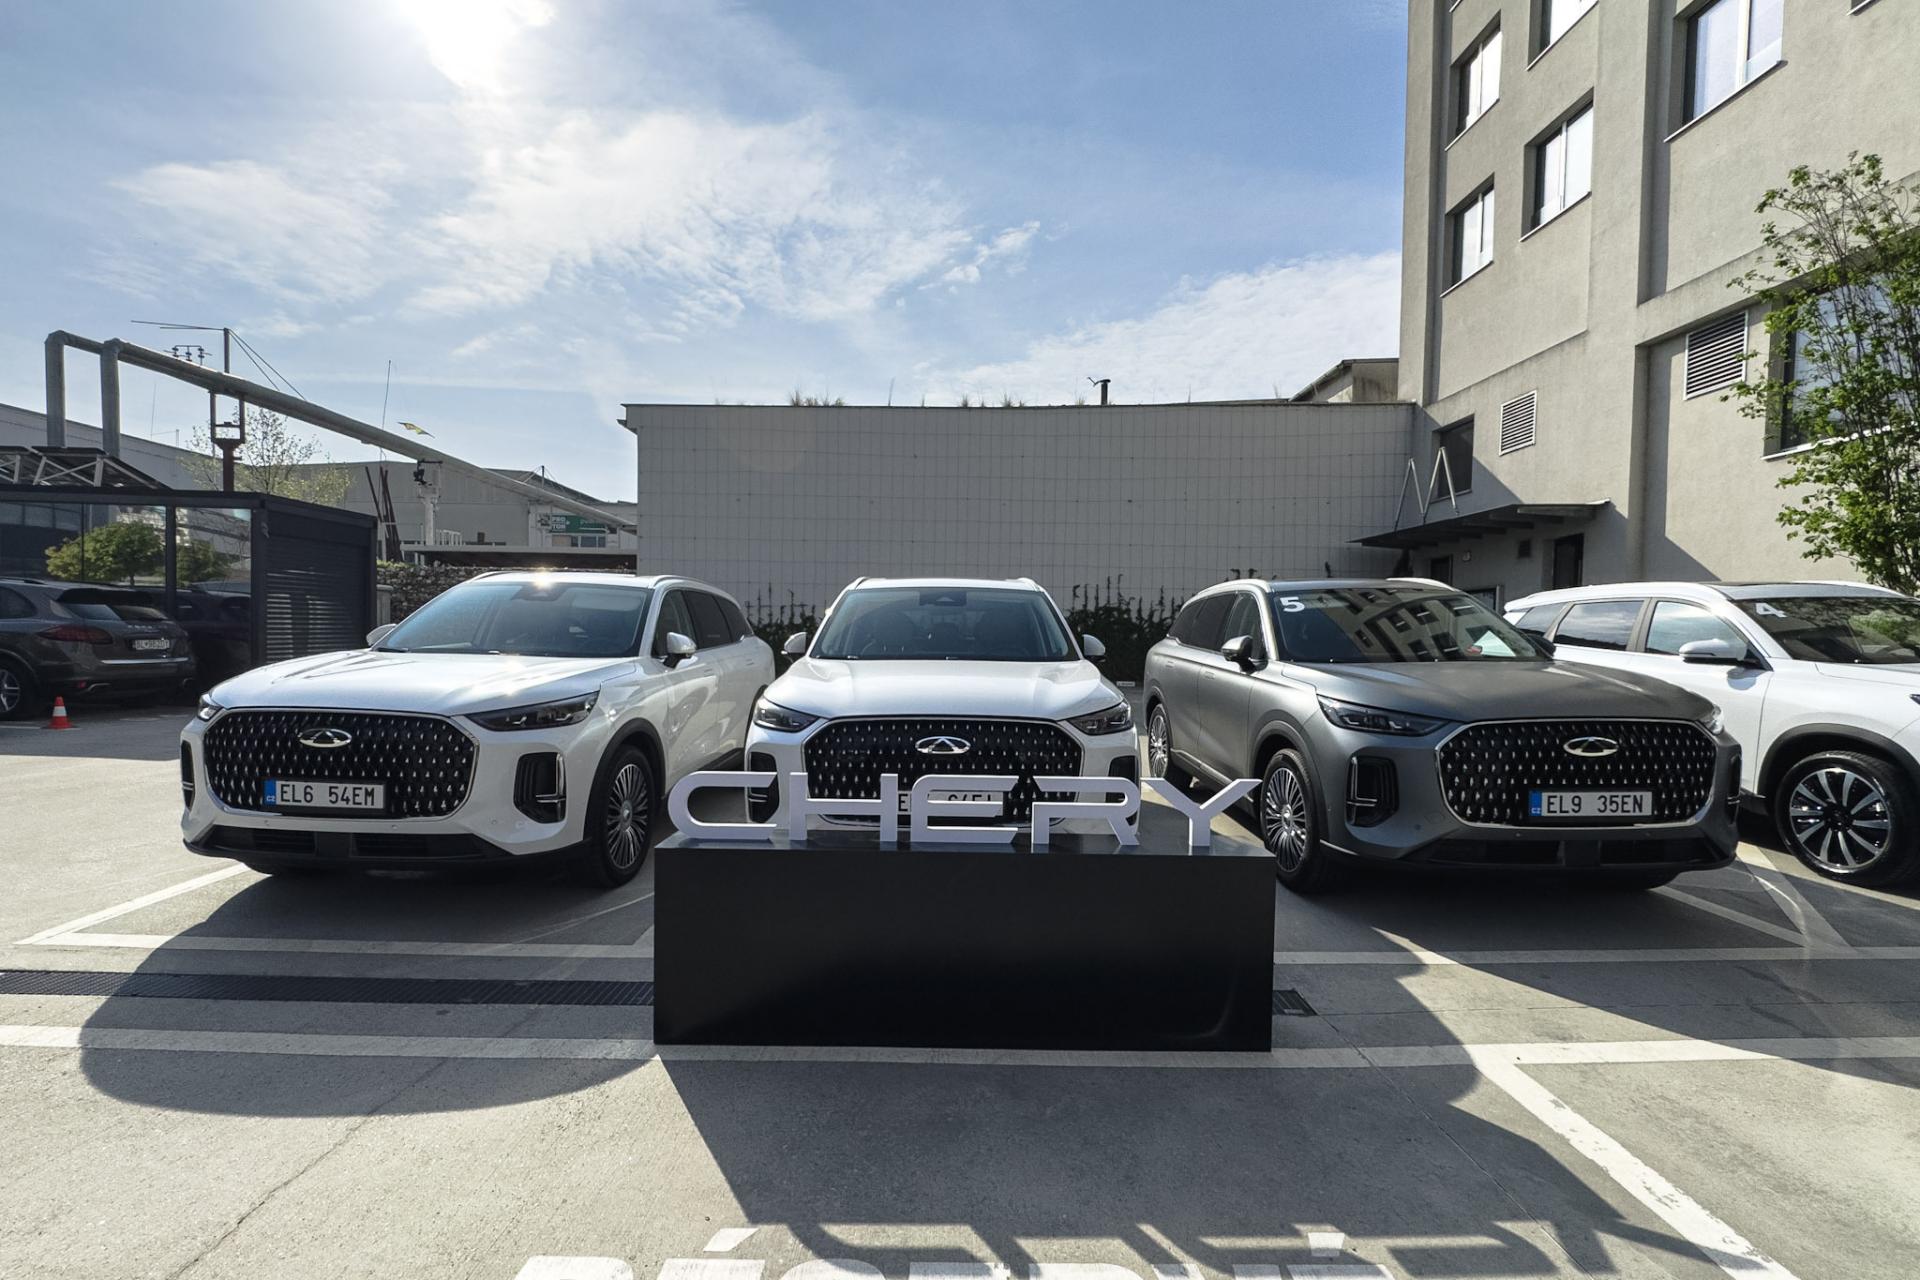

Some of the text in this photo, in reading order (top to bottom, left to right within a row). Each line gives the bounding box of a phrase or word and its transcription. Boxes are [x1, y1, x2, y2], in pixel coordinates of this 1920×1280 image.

[1280, 596, 1305, 612] 5
[1755, 602, 1788, 618] 4
[280, 783, 314, 803] EL6
[328, 786, 375, 806] 54EM
[1546, 794, 1582, 814] EL9
[1597, 794, 1643, 813] 35EN
[667, 770, 1263, 848] CHERY
